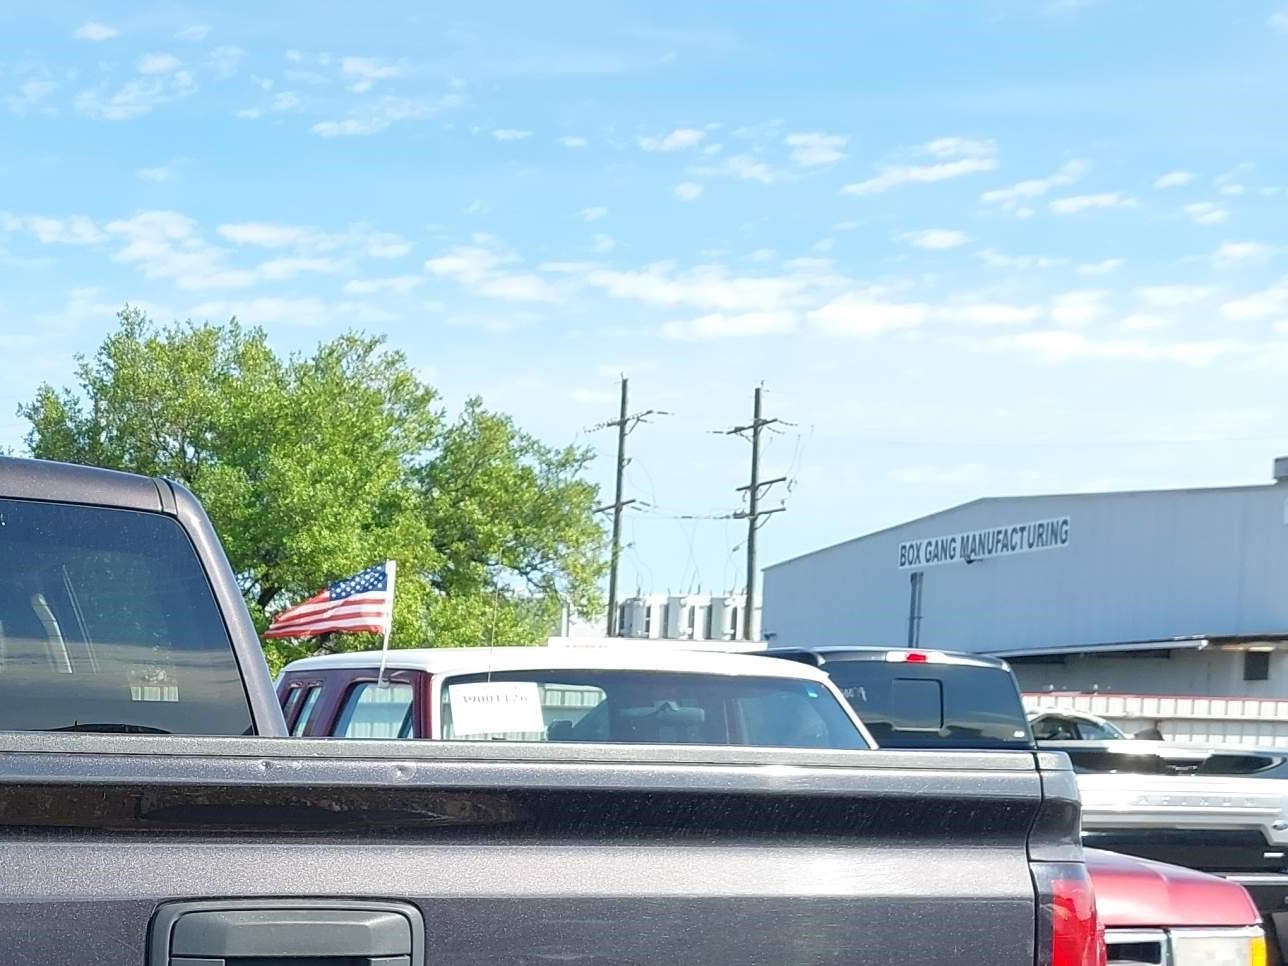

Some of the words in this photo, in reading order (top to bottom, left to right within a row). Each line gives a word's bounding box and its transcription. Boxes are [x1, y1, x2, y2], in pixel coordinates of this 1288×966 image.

[899, 542, 923, 567] BOX
[924, 537, 956, 563] GANG
[959, 519, 1070, 559] MANUFACTURING
